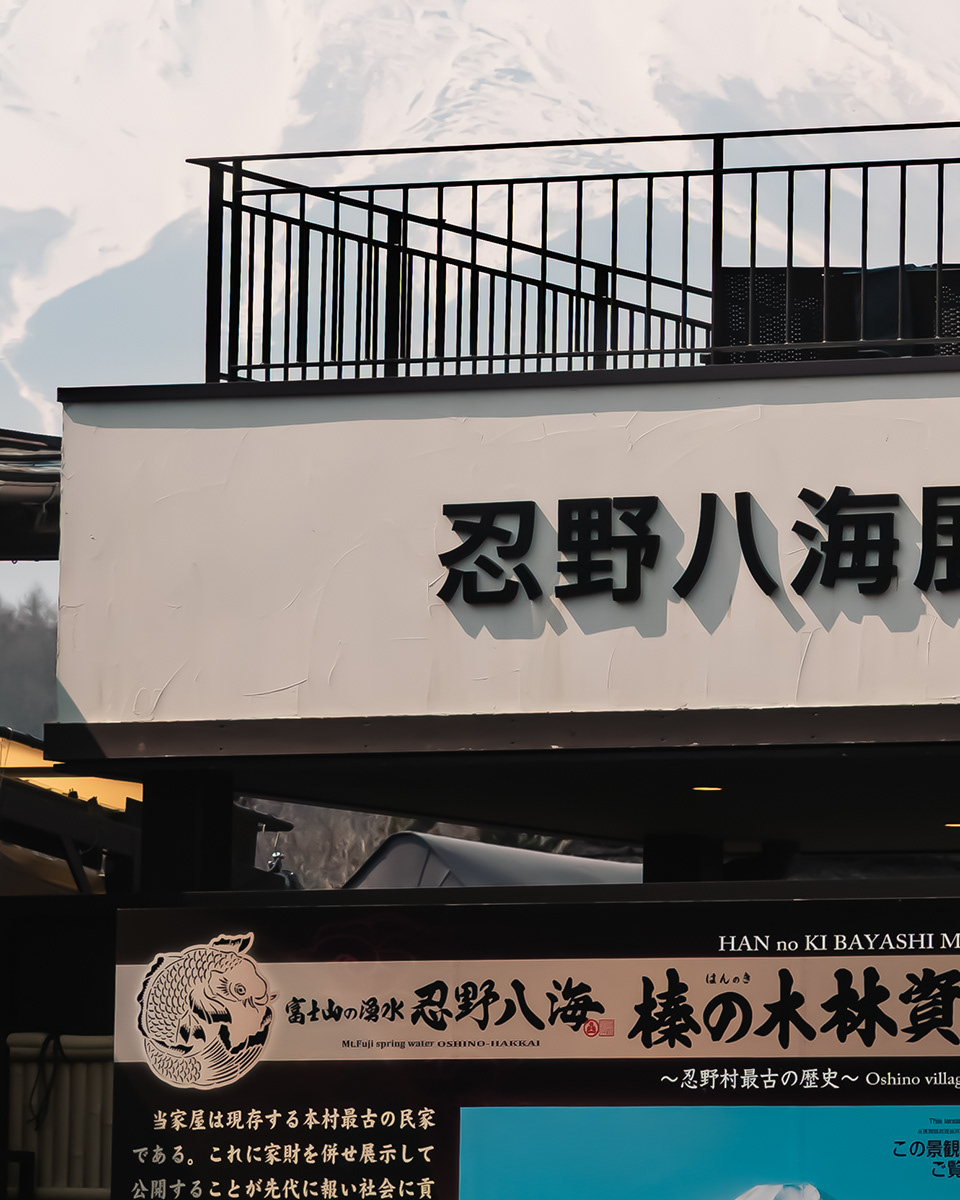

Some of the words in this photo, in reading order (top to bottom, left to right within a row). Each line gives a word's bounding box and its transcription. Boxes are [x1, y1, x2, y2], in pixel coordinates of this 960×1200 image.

[718, 935, 770, 952] HAN
[776, 940, 799, 952] no
[804, 934, 828, 951] KI
[833, 933, 935, 951] BAYASHI
[705, 971, 751, 985] はんのき
[285, 996, 405, 1025] 富士山の湧水
[410, 976, 605, 1033] 忍野八海
[341, 1039, 374, 1049] Mt.Fuji
[375, 1039, 406, 1050] spring
[407, 1040, 435, 1048] water
[437, 1040, 541, 1048] OSHINO-HAKKAI
[865, 1071, 921, 1086] Oshino
[153, 1107, 436, 1132] 当家屋は現存する本村最古の民家
[132, 1142, 435, 1166] である。これに家財を併せ展示して
[131, 1176, 436, 1200] 公開することが先代に報い社会に貢
